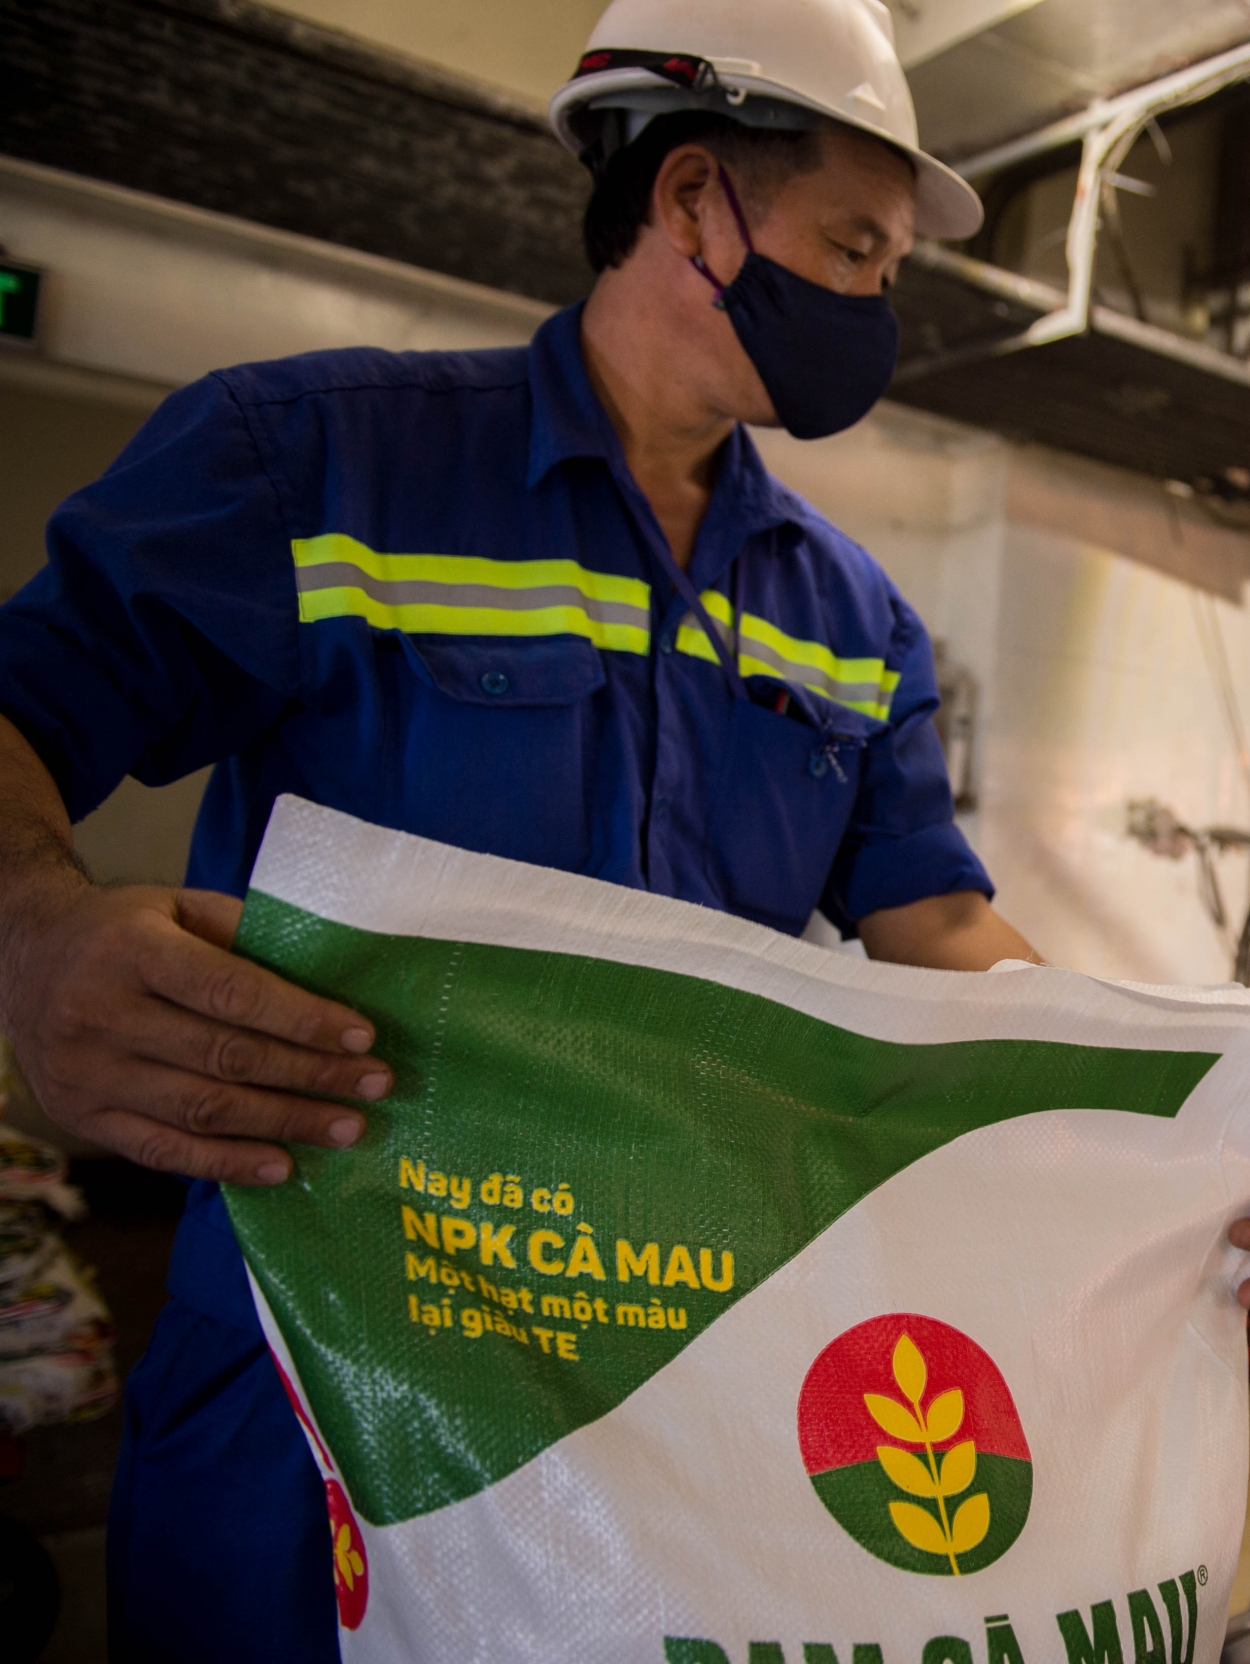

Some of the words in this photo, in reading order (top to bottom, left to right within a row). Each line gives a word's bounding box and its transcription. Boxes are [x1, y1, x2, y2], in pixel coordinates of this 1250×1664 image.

[400, 1155, 471, 1209] Nay
[480, 1172, 524, 1208] đã
[531, 1182, 574, 1215] có
[401, 1205, 517, 1269] NPK
[528, 1221, 607, 1282] CÀ
[616, 1239, 736, 1293] MAU
[406, 1252, 476, 1295] Một
[477, 1274, 535, 1316] hạt
[540, 1291, 609, 1330] một
[616, 1299, 688, 1330] màu
[408, 1294, 453, 1336] lại
[460, 1304, 530, 1345] giàu
[531, 1326, 579, 1362] TE
